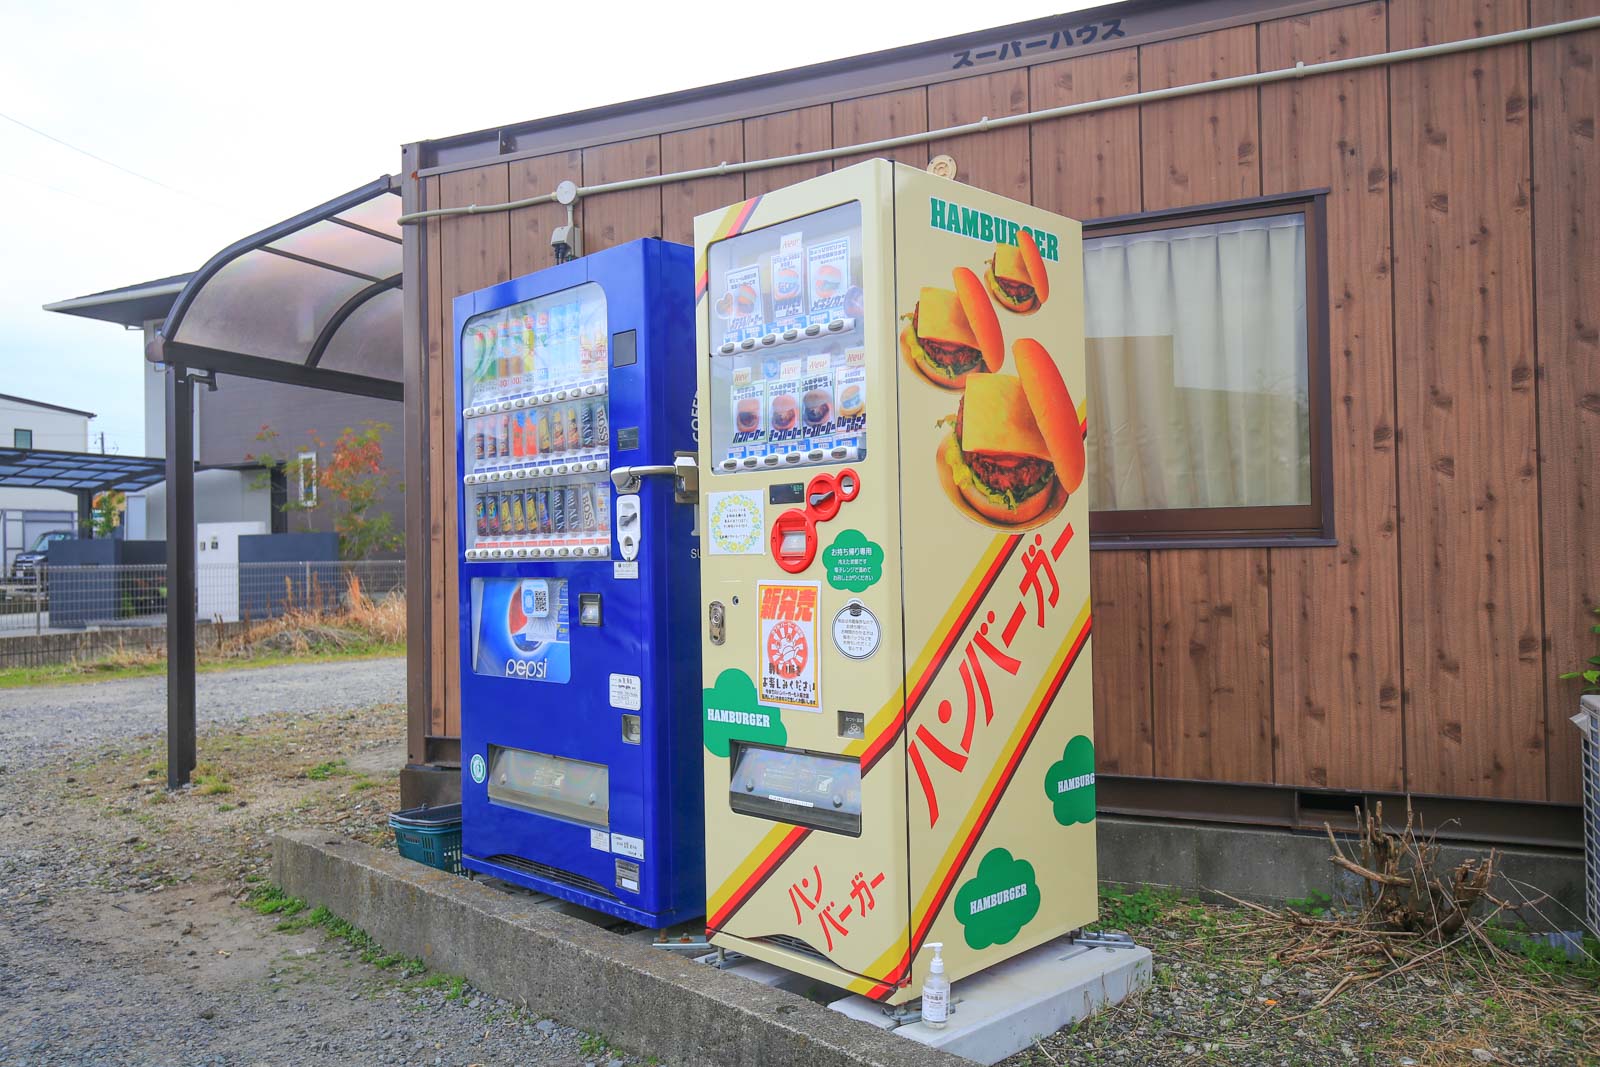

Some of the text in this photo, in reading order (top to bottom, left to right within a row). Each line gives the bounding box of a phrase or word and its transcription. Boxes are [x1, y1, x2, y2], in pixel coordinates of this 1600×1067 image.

[952, 18, 1126, 69] スーパーハウス
[597, 409, 608, 443] BOSS
[761, 588, 816, 622] 新発売
[506, 658, 548, 679] pepsi
[907, 522, 1075, 830] ハンバーガー
[707, 708, 771, 728] HAMBURGER
[1057, 772, 1095, 794] HAMBURG
[969, 883, 1028, 916] HAMBURGER
